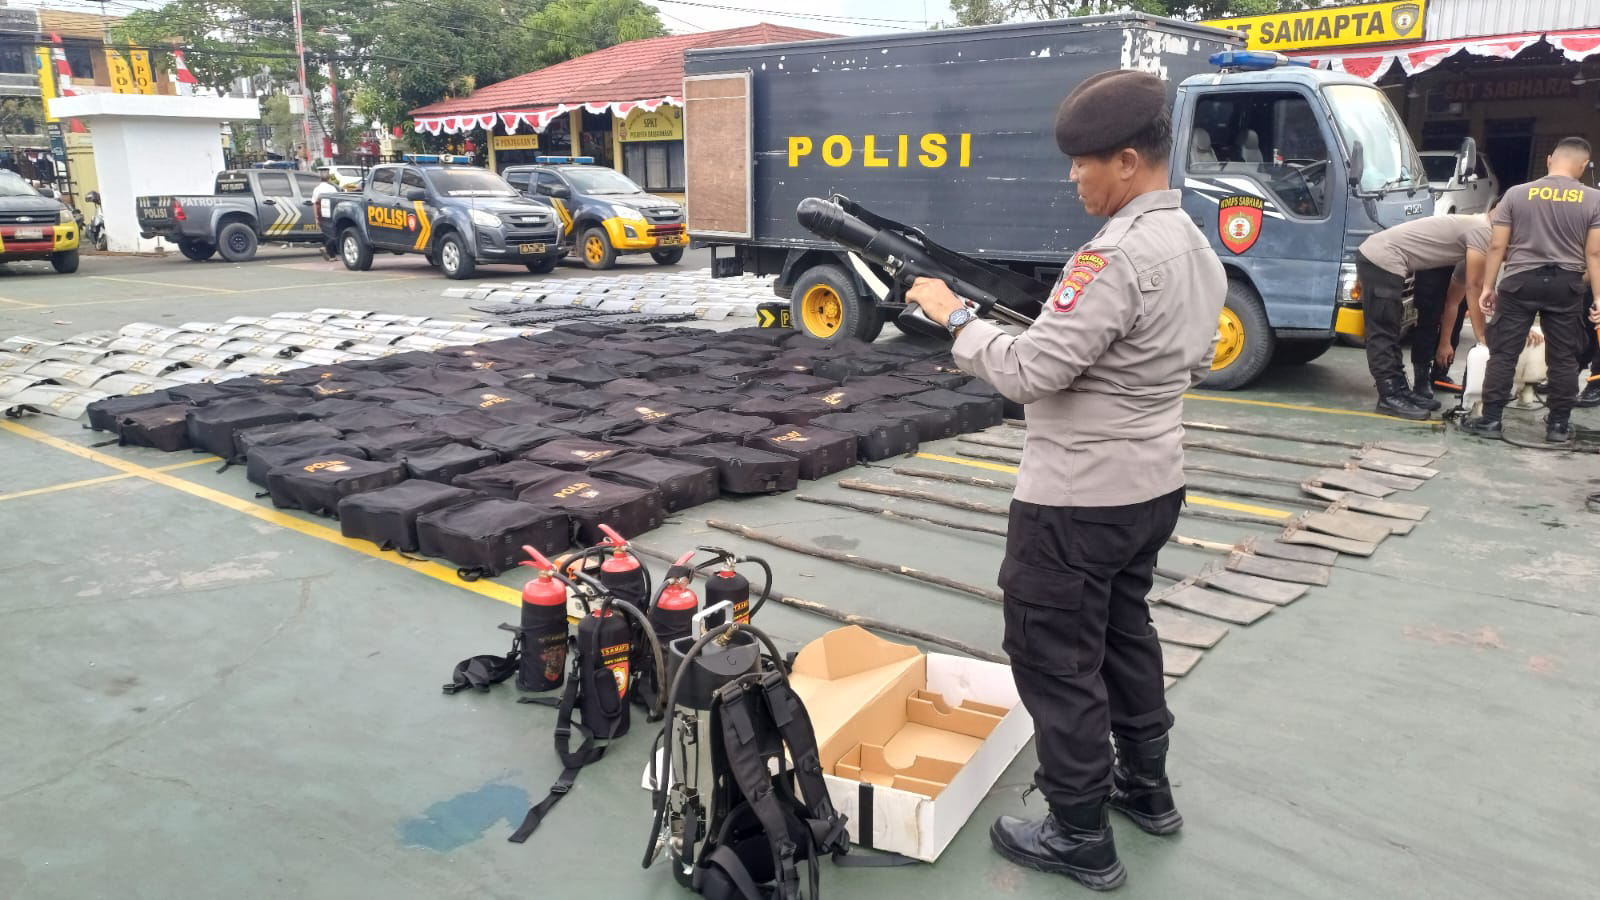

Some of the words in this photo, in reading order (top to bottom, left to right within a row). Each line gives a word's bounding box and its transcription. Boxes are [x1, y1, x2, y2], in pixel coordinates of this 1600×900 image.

[1259, 11, 1385, 44] SAMAPTA
[1485, 79, 1571, 98] SABHARA
[788, 133, 971, 168] POLISI
[1528, 186, 1584, 203] POLISI
[143, 208, 168, 218] POLISI
[367, 206, 407, 227] POLISI
